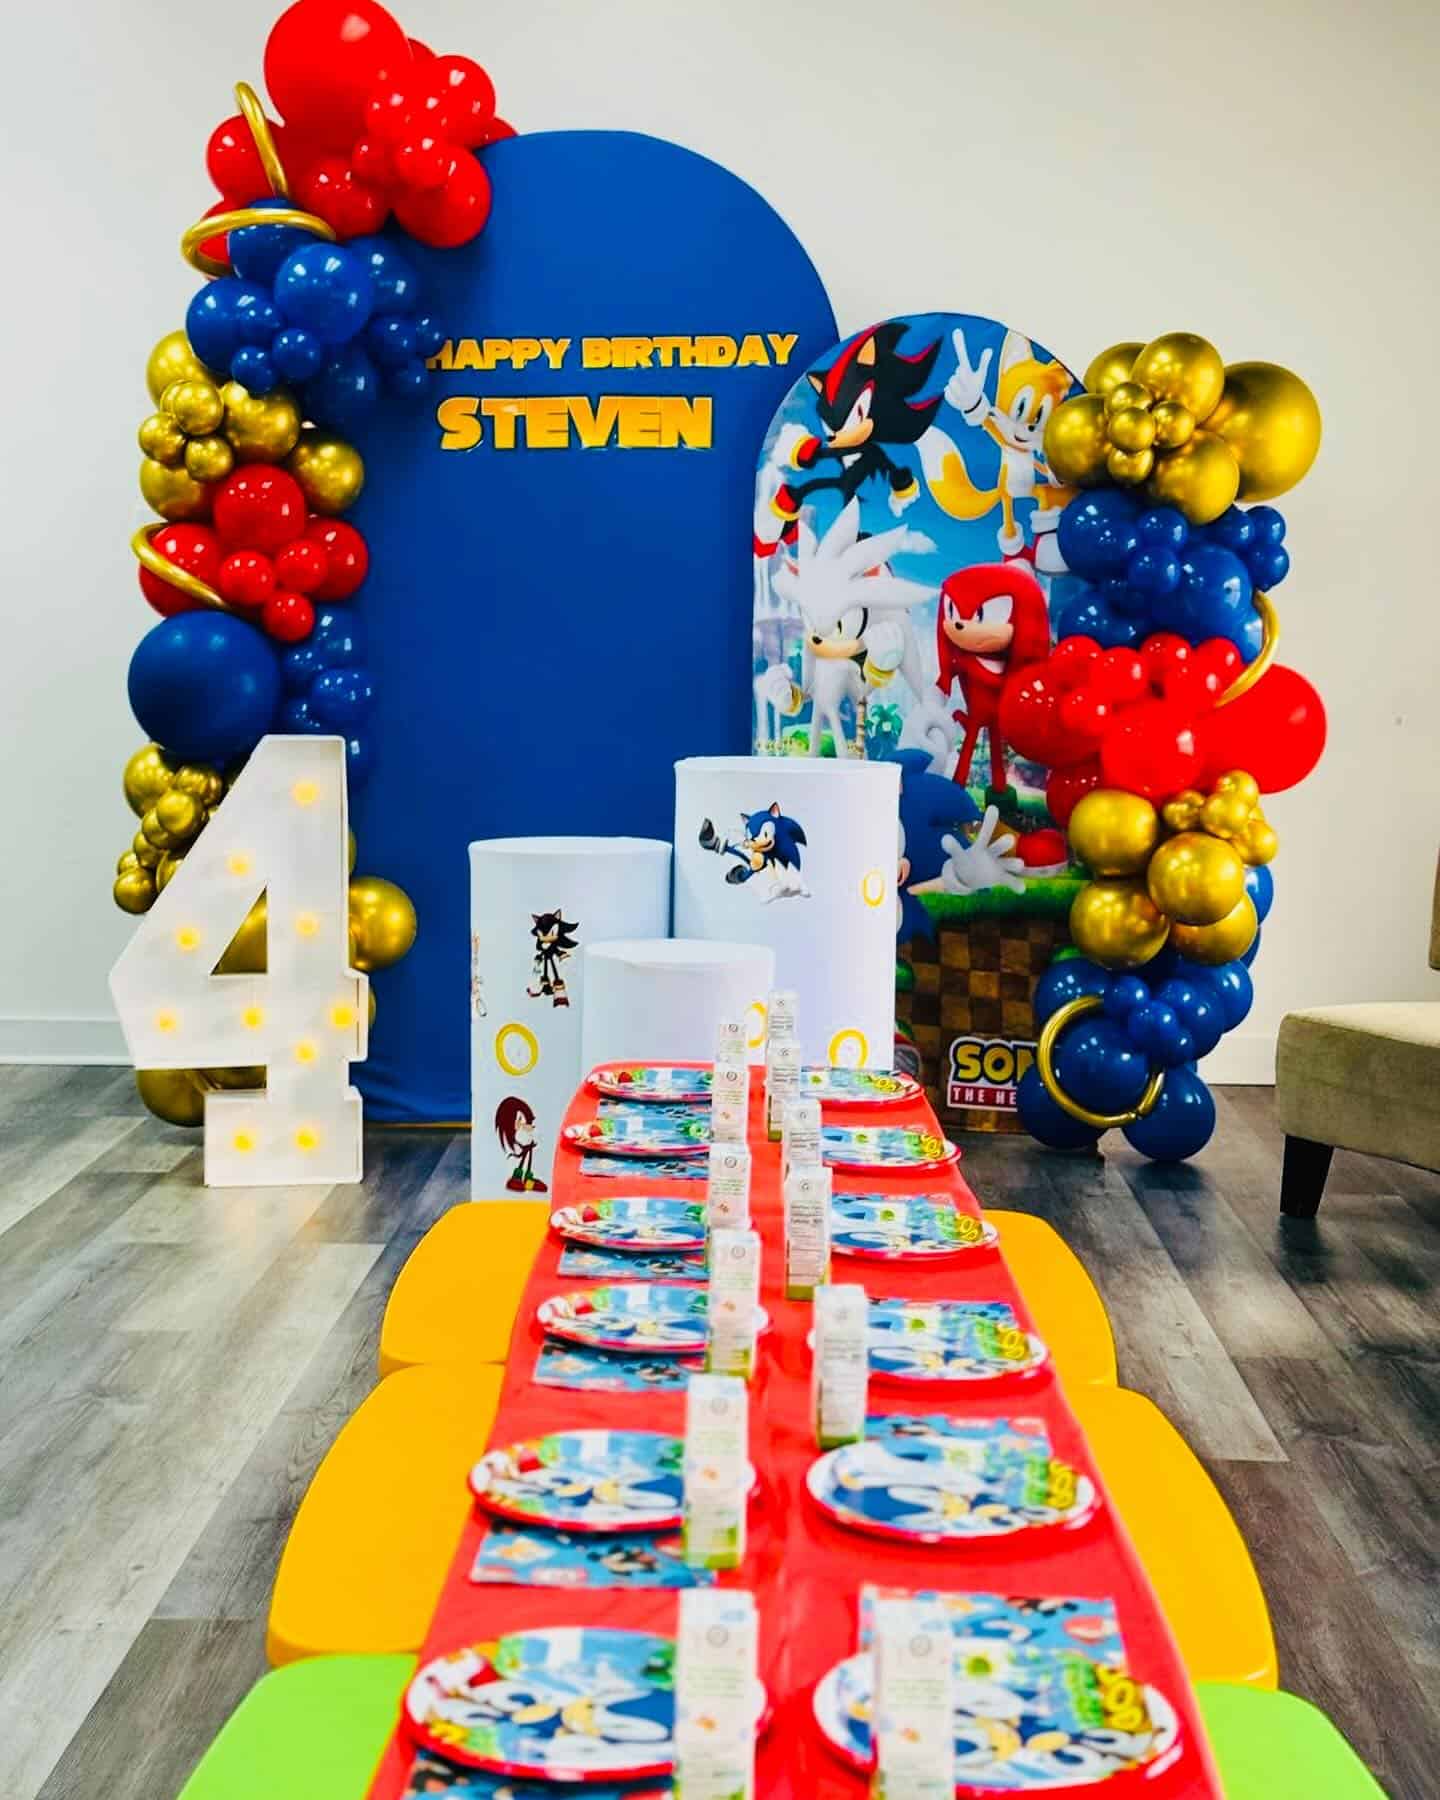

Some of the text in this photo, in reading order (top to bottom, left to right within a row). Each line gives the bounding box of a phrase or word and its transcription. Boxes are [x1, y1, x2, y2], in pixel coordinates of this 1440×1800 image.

[425, 333, 799, 371] HAPPY BIRTHDAY
[436, 396, 714, 451] STEVEN
[108, 733, 369, 1188] 4
[952, 1086, 986, 1104] THE
